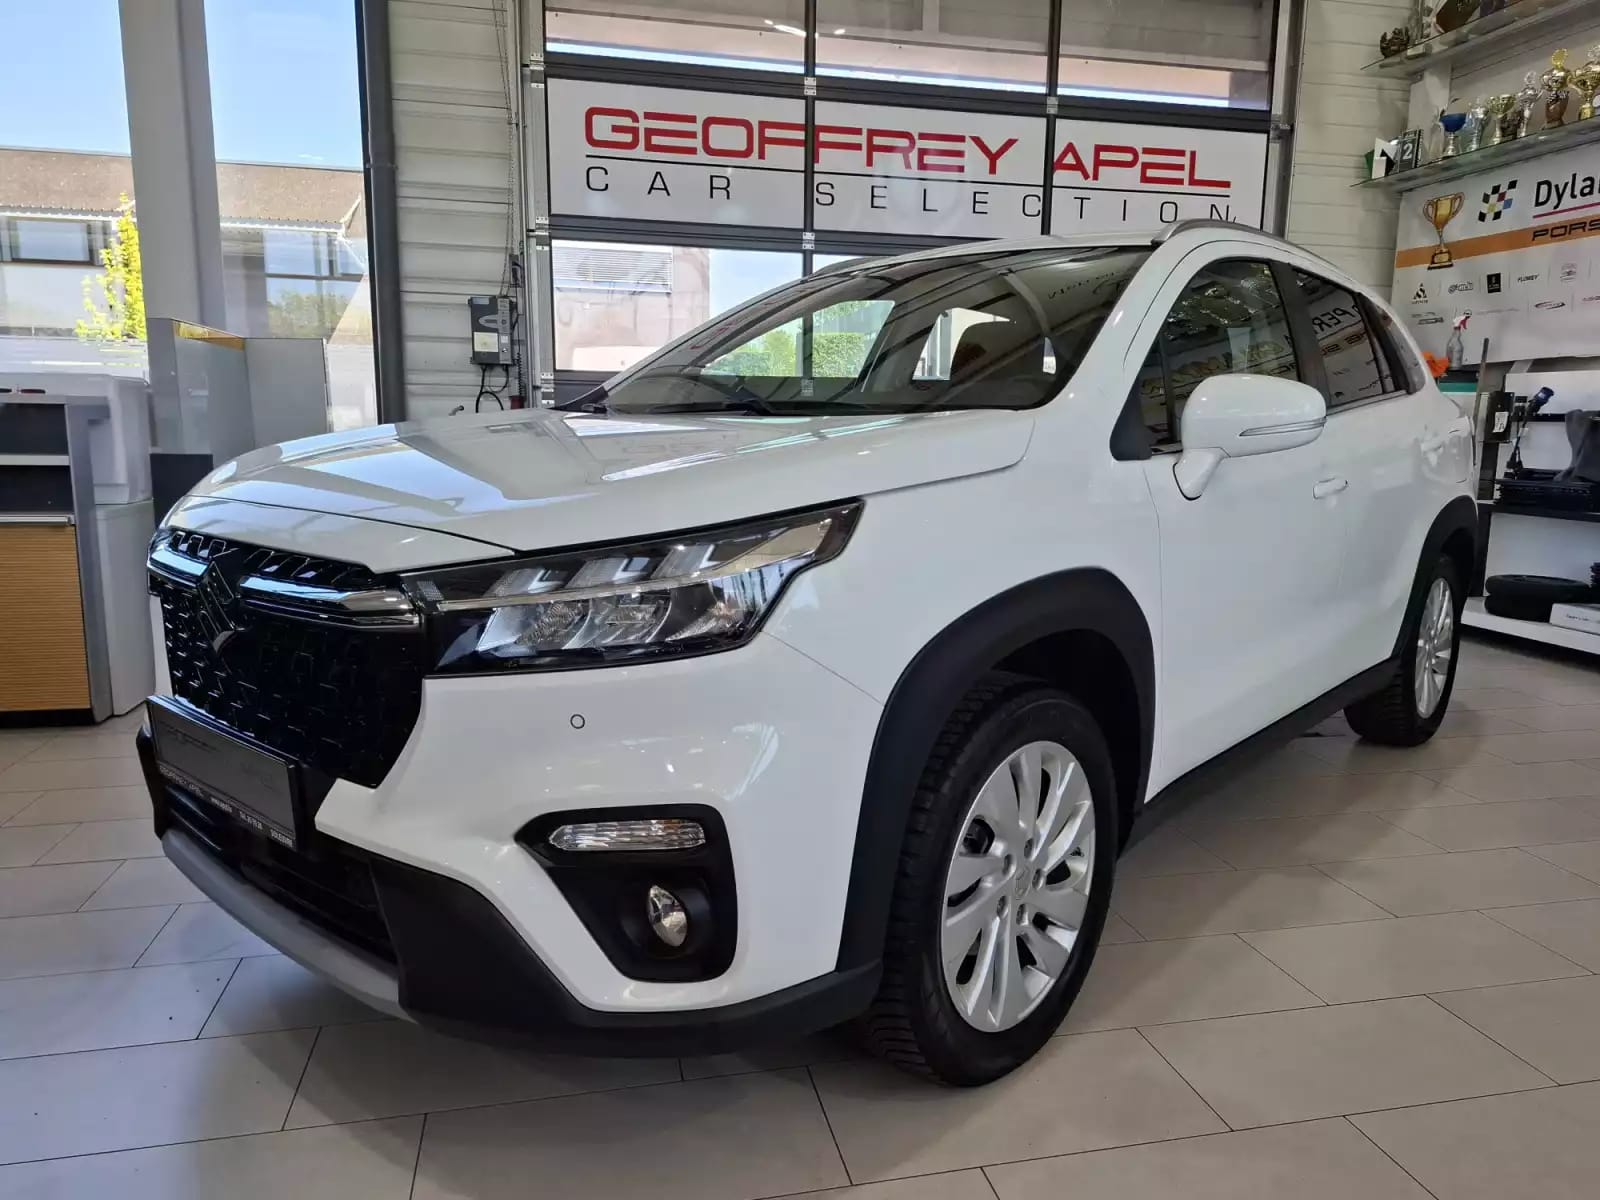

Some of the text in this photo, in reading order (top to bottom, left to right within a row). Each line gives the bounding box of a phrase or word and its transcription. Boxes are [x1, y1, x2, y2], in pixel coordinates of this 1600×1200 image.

[585, 106, 1232, 189] GEOFFREY APEL
[585, 166, 1230, 223] CAR SELECTION
[1534, 172, 1600, 210] Dyla
